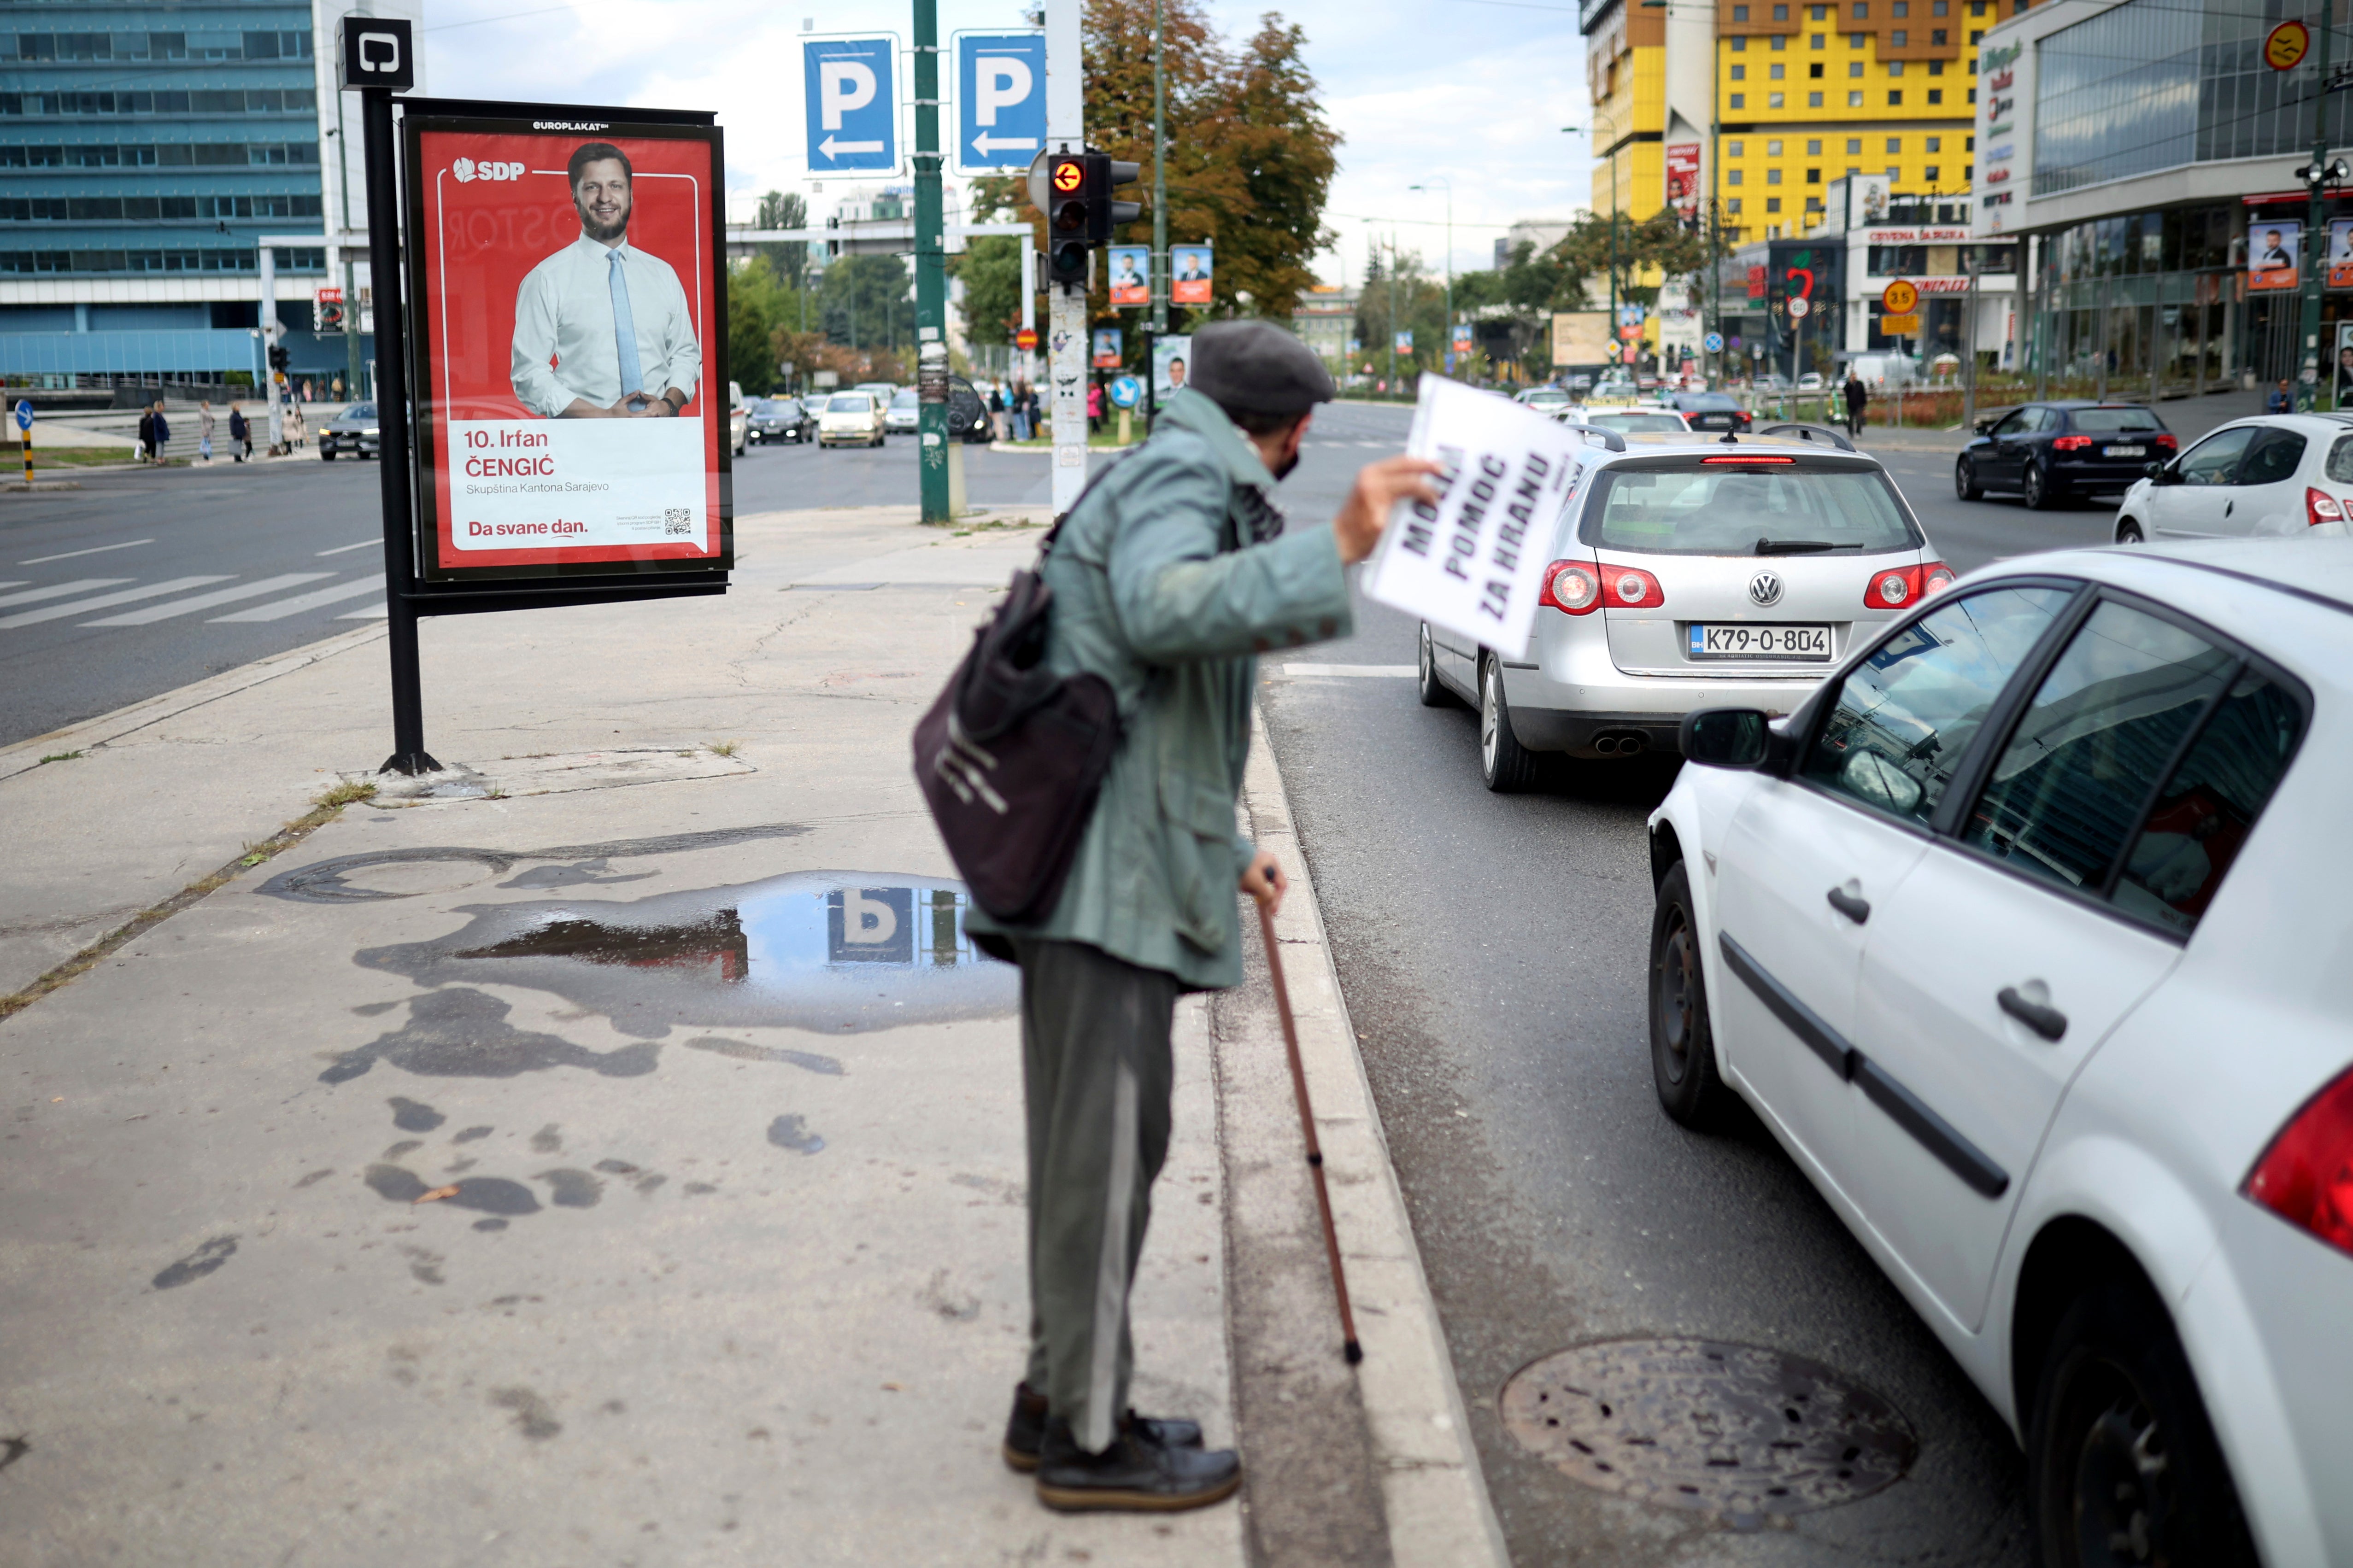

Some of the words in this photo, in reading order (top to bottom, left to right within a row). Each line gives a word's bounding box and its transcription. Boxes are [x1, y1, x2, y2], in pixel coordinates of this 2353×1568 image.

[820, 61, 876, 130] P
[976, 57, 1033, 126] P
[477, 162, 525, 181] SDP
[464, 430, 494, 448] 10.
[500, 430, 548, 447] Irfan
[465, 454, 554, 477] ČENGIĆ
[466, 484, 518, 495] Skupština
[520, 484, 563, 492] Kantona
[565, 482, 609, 492] Sarajevo
[1493, 453, 1549, 571] HRANU
[469, 521, 493, 536] Da
[497, 523, 548, 535] svane
[552, 519, 588, 533] dan.
[1480, 581, 1510, 620] ZA
